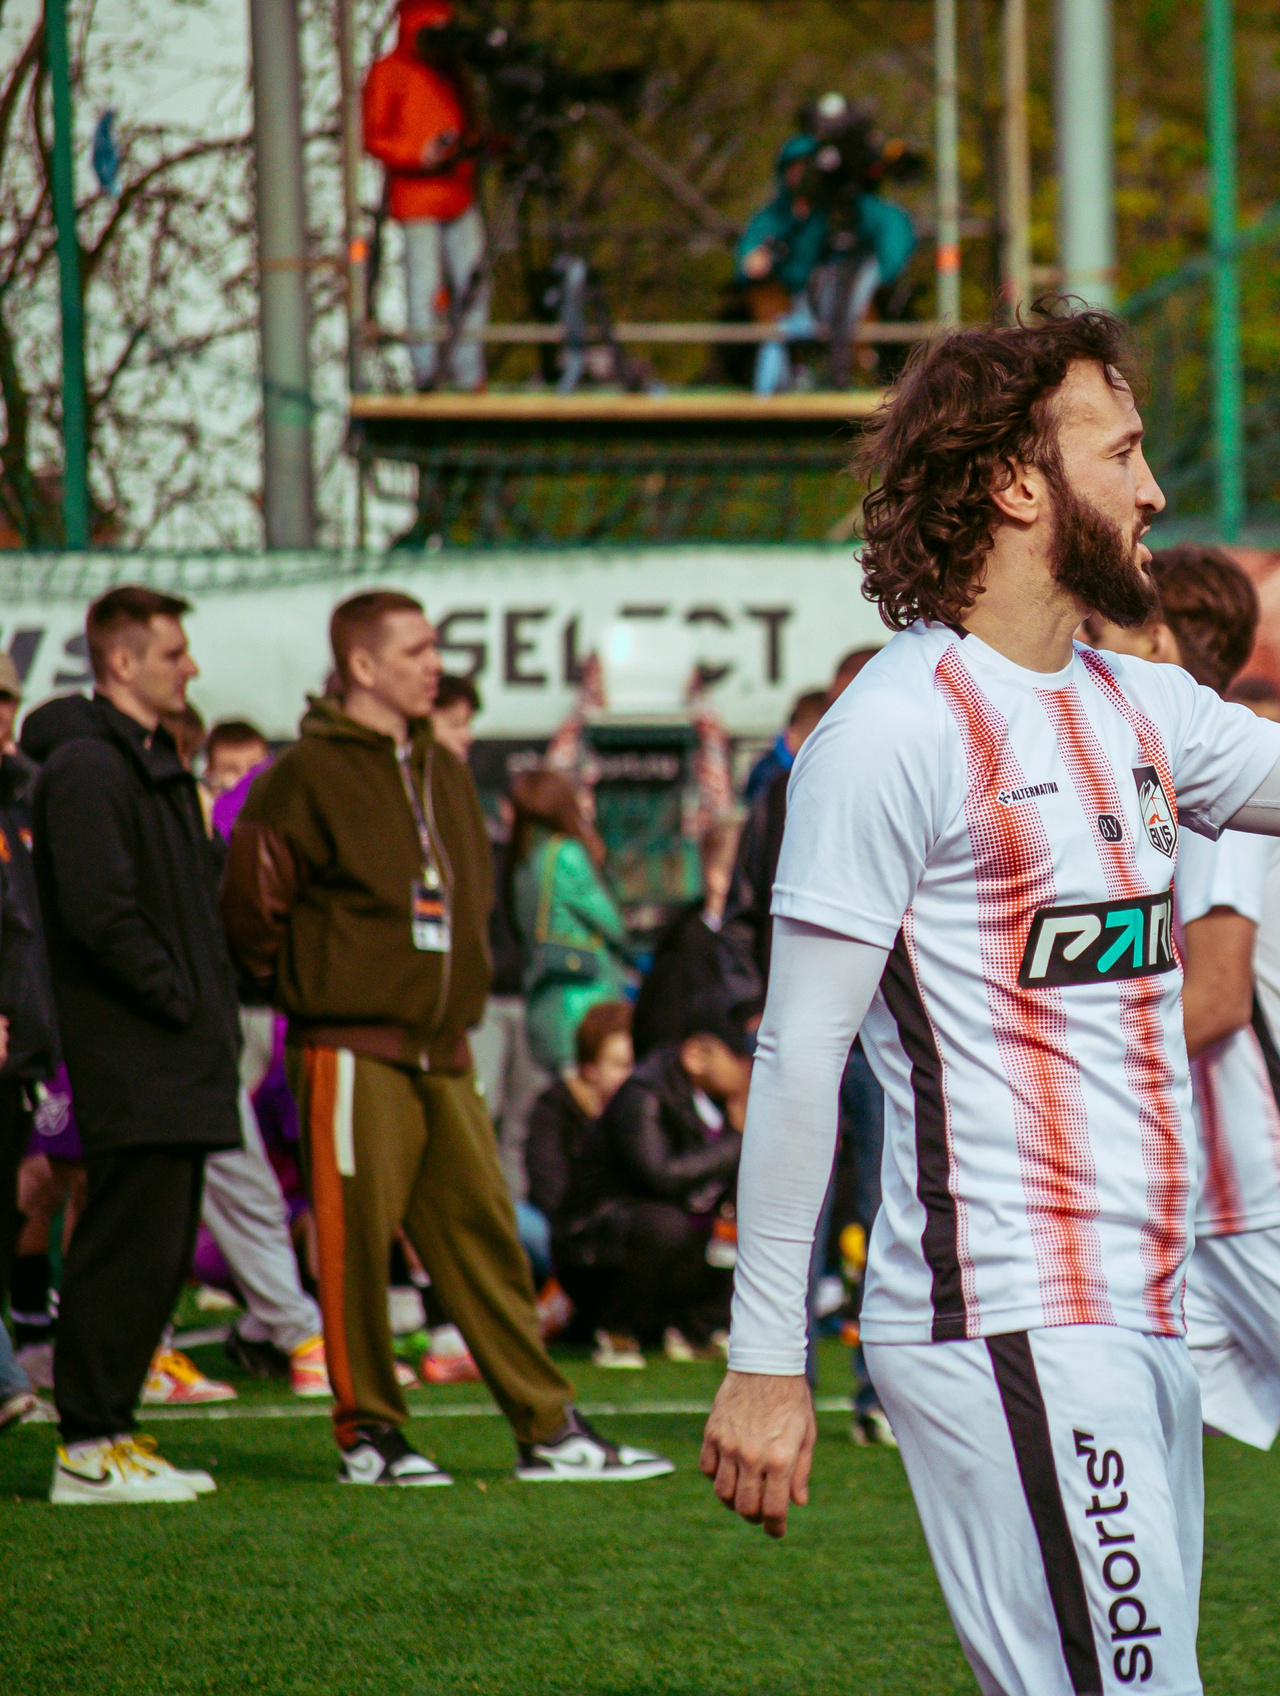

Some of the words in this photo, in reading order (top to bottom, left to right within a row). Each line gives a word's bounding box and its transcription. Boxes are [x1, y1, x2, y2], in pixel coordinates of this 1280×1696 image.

[435, 604, 793, 688] SELCT
[1011, 781, 1060, 802] ALTERNATIVA
[1149, 824, 1173, 853] BUS
